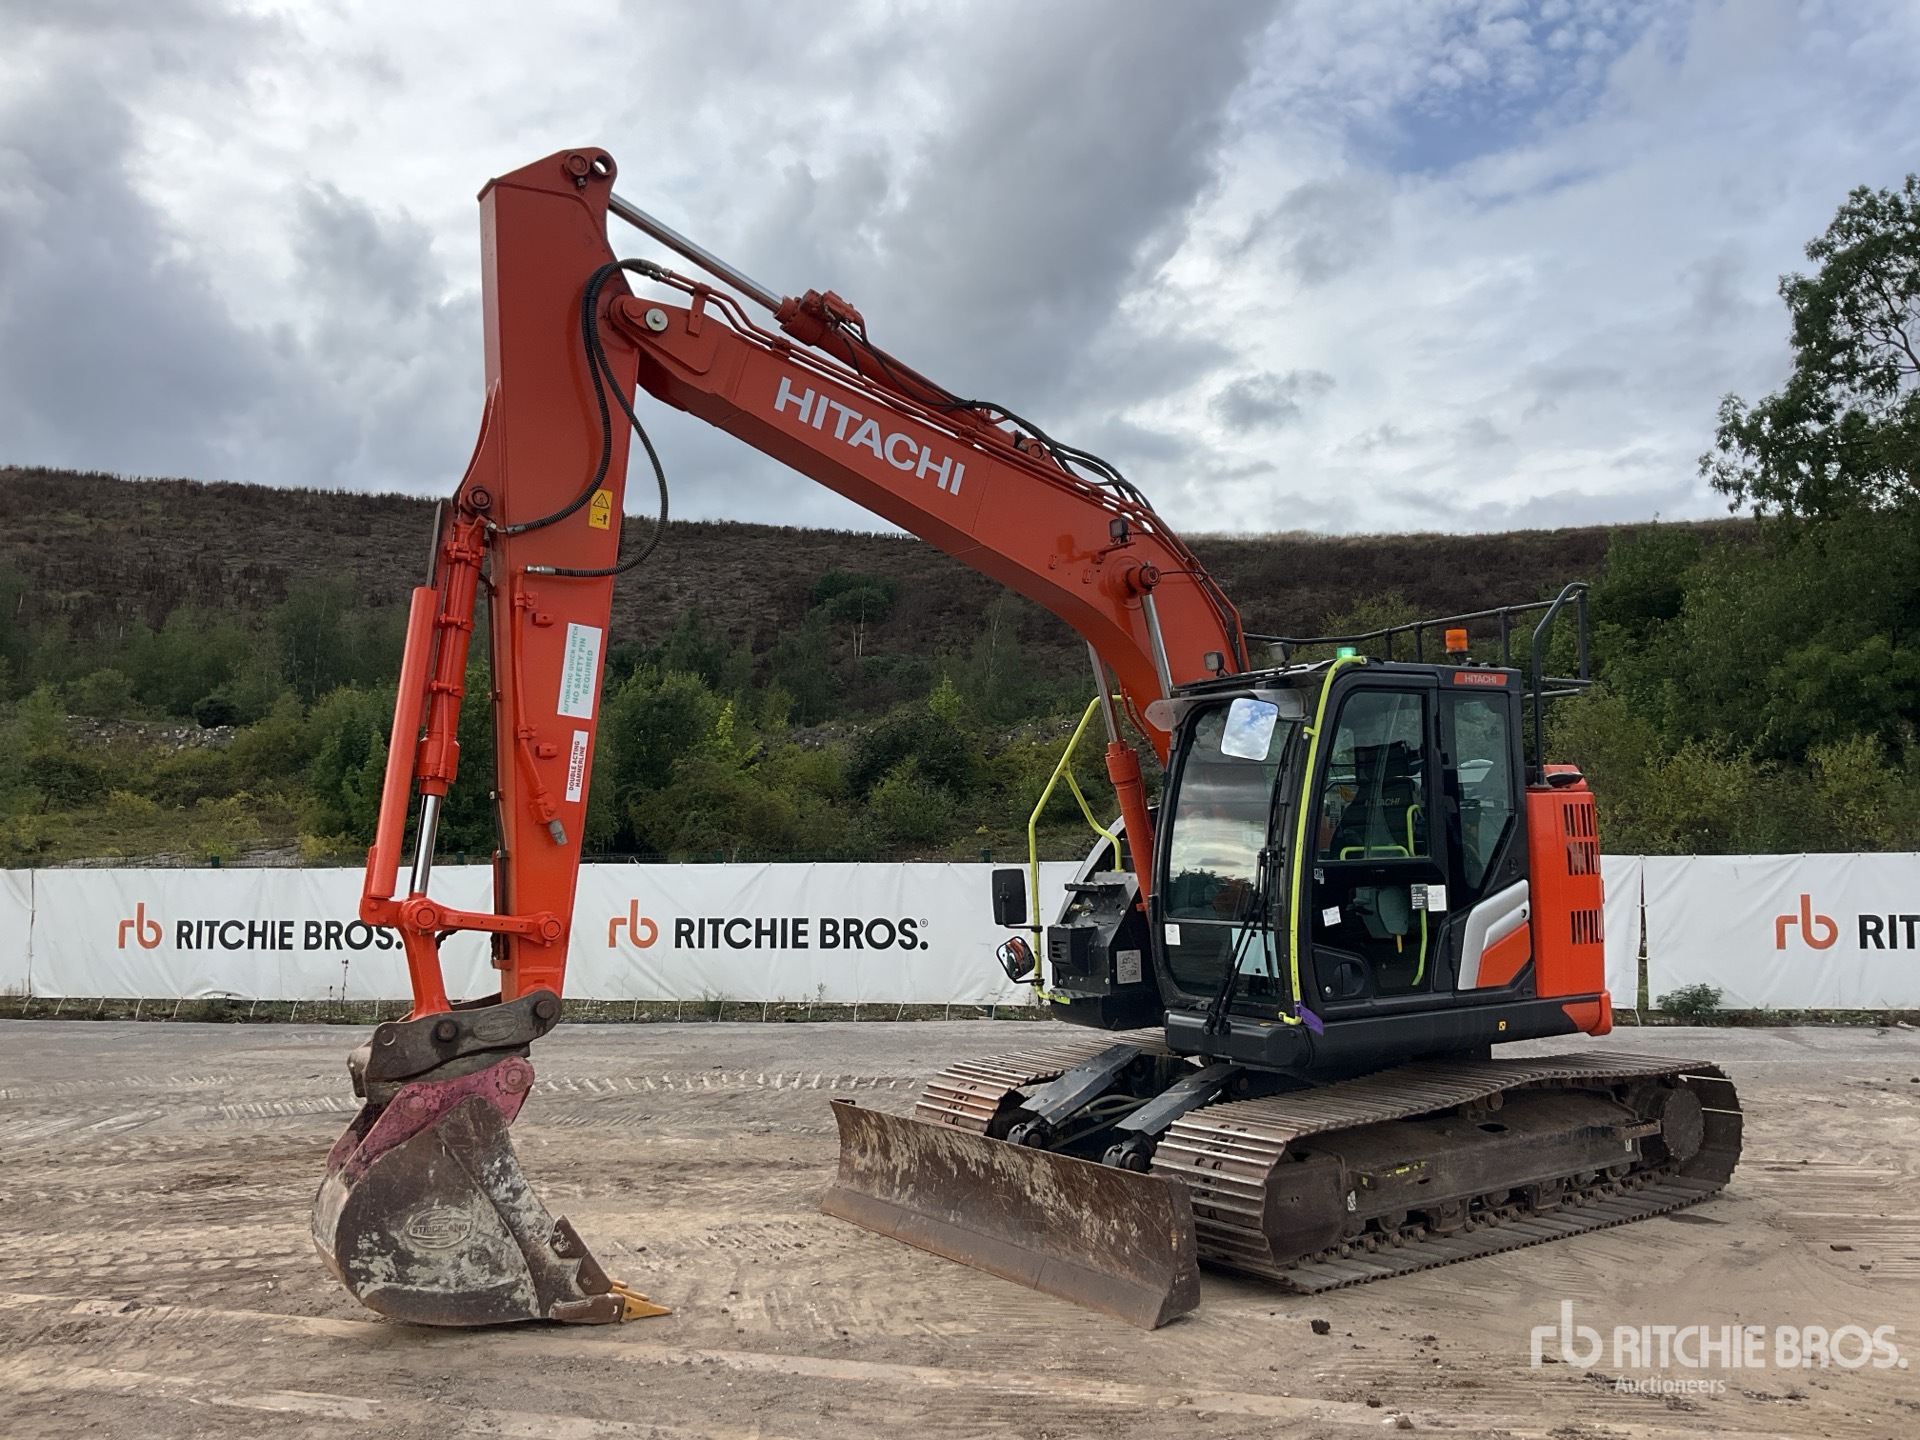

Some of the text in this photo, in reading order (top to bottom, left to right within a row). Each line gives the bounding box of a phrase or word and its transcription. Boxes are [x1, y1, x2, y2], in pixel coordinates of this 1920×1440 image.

[774, 376, 965, 496] HITACHI
[563, 625, 579, 713] AUTOMATIC QUICK HITCH
[572, 638, 586, 704] NO SAFETY PIN
[582, 649, 594, 695] REQUIRED
[1464, 674, 1497, 684] HITACHI
[568, 740, 580, 791] DOUBLE ACTING
[575, 746, 586, 788] HAMMERLINE
[118, 902, 404, 951] rb RITCHIE BROS.
[608, 899, 659, 949] rb
[674, 917, 809, 950] RITCHIE
[1775, 894, 1839, 950] rb
